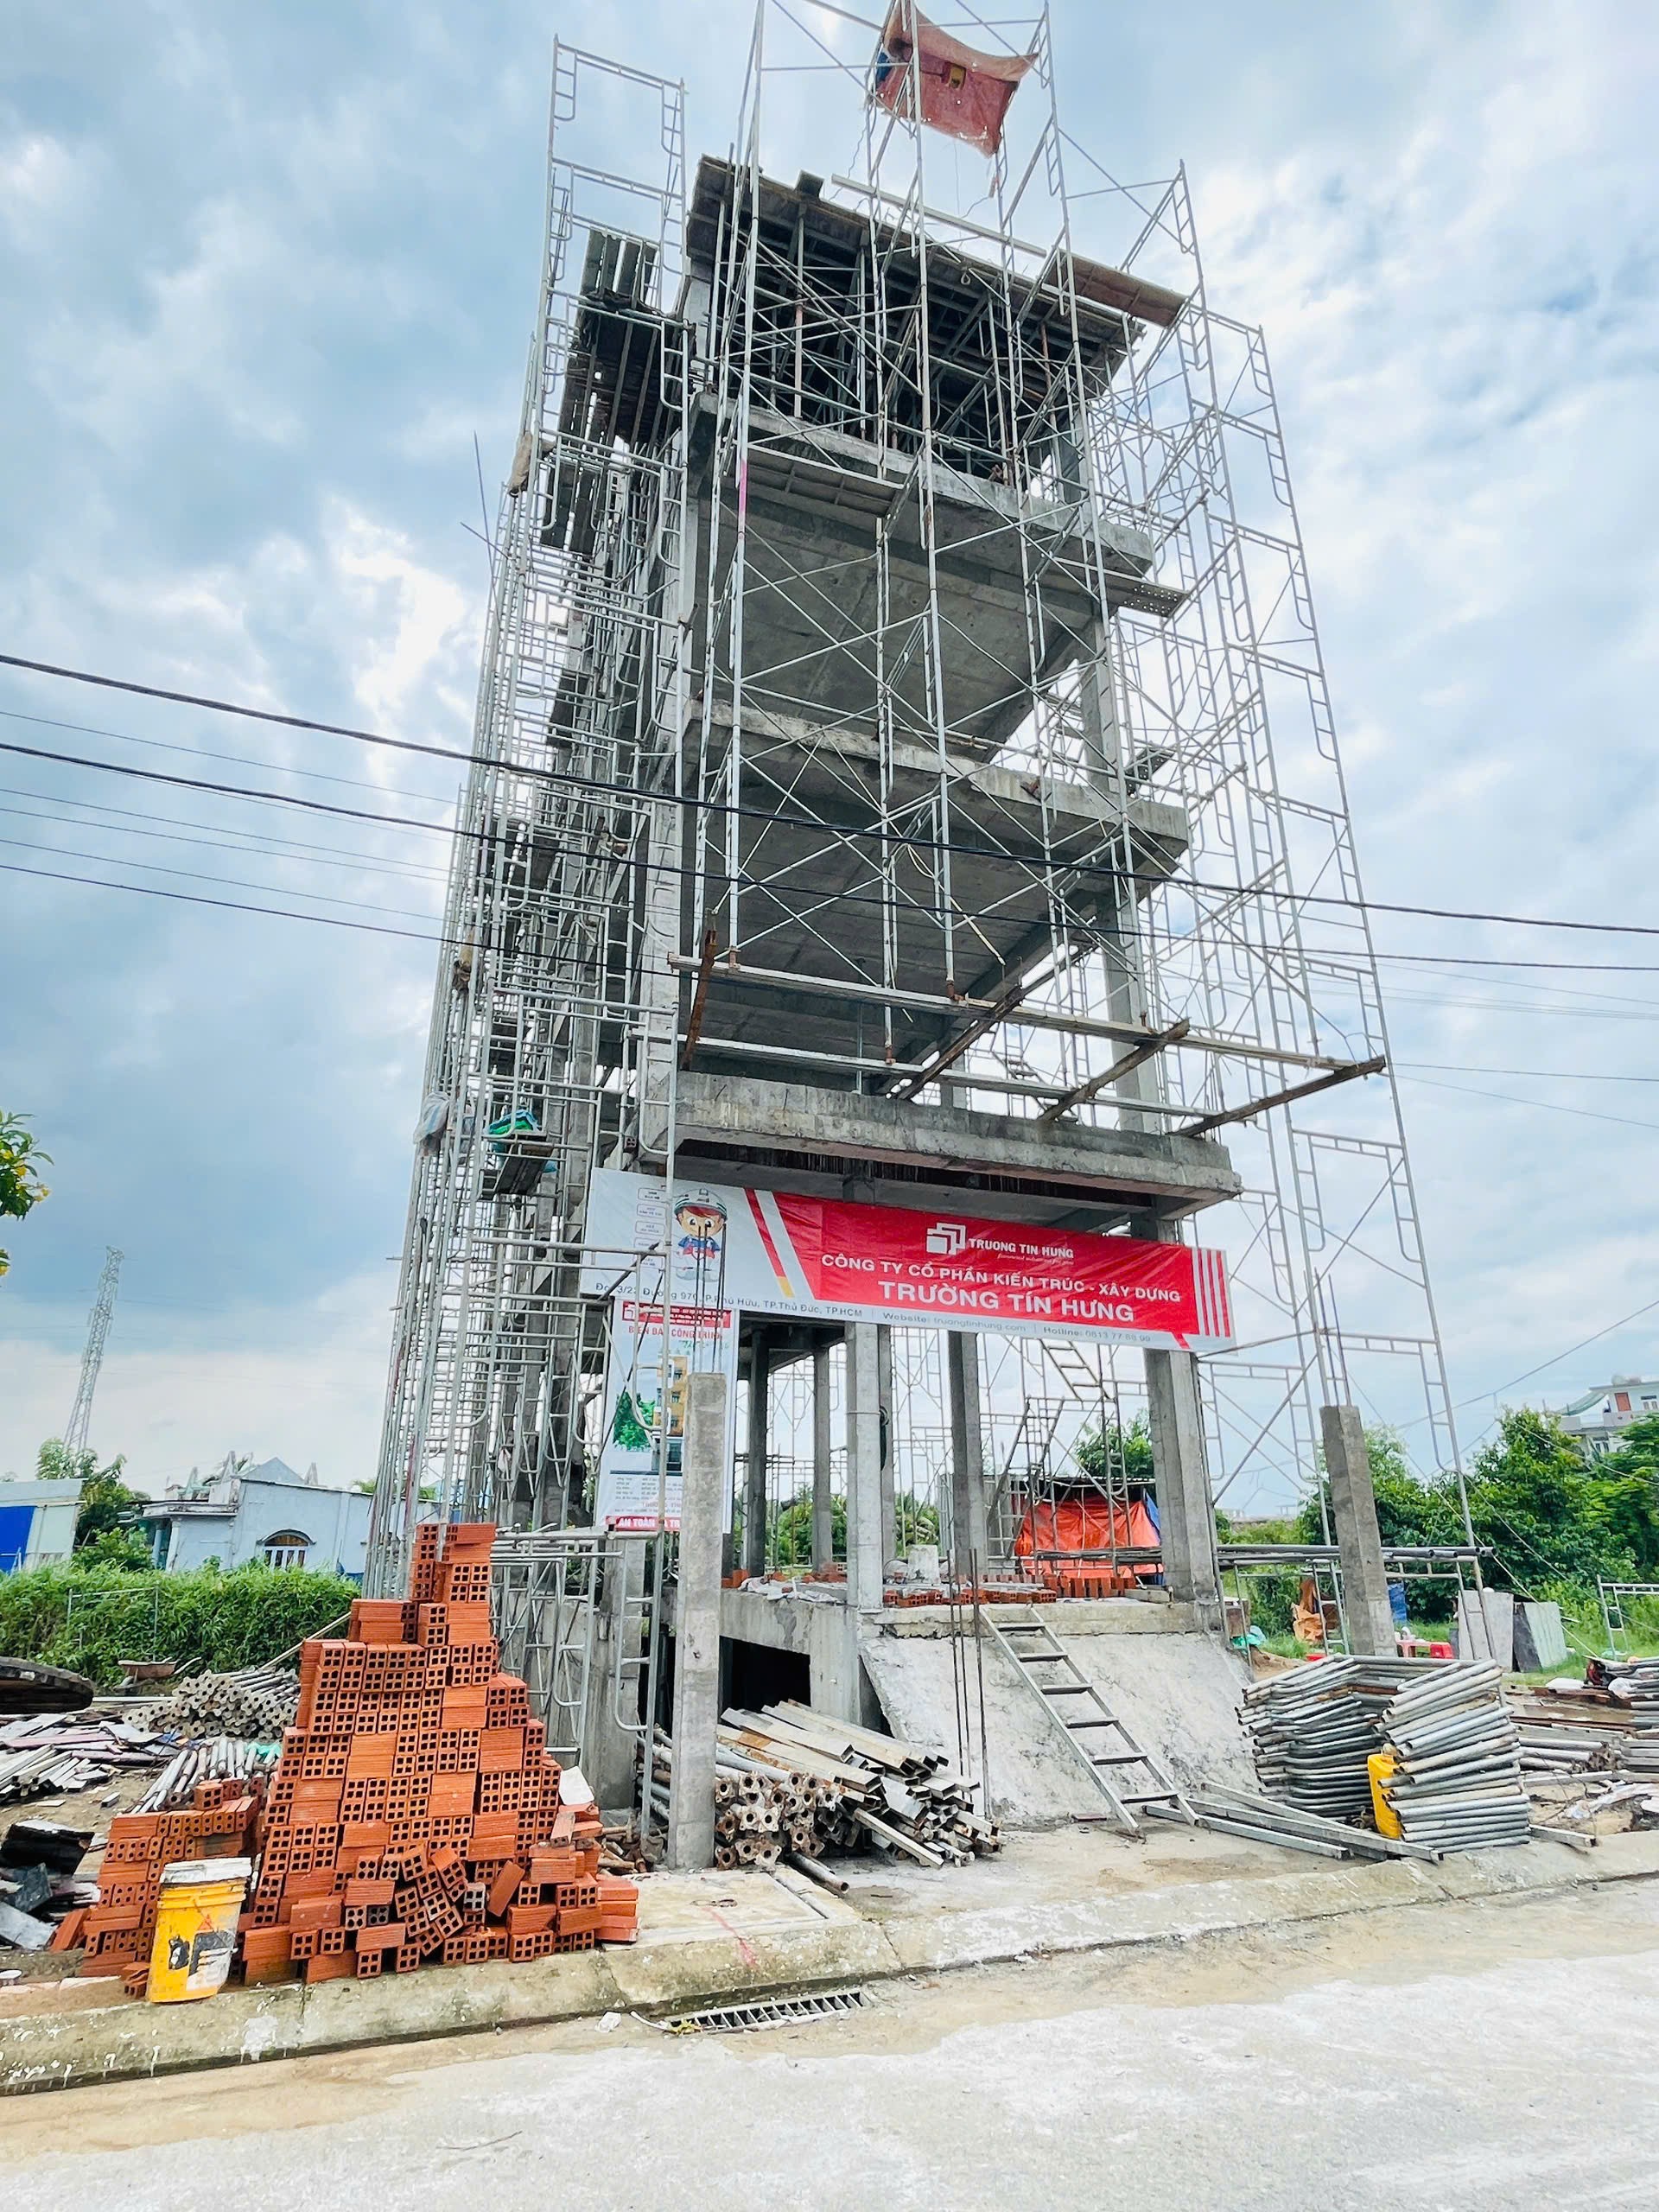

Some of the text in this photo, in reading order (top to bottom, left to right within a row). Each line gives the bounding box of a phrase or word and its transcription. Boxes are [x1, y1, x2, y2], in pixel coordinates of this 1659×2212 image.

[968, 1238, 1016, 1253] TRUONG
[1020, 1243, 1039, 1255] TIN
[1041, 1247, 1074, 1259] HUNG
[822, 1253, 875, 1271] CÔNG
[880, 1261, 903, 1274] TY
[939, 1267, 988, 1283] PHẦN
[994, 1271, 1033, 1287] KIẾN
[1038, 1277, 1084, 1292] TRÚC
[1098, 1283, 1130, 1297] XÂY
[1135, 1286, 1180, 1302] DỰNG
[826, 1306, 863, 1317] TP.HCM
[878, 1280, 1134, 1322] TRƯỜNG TÍN HƯNG
